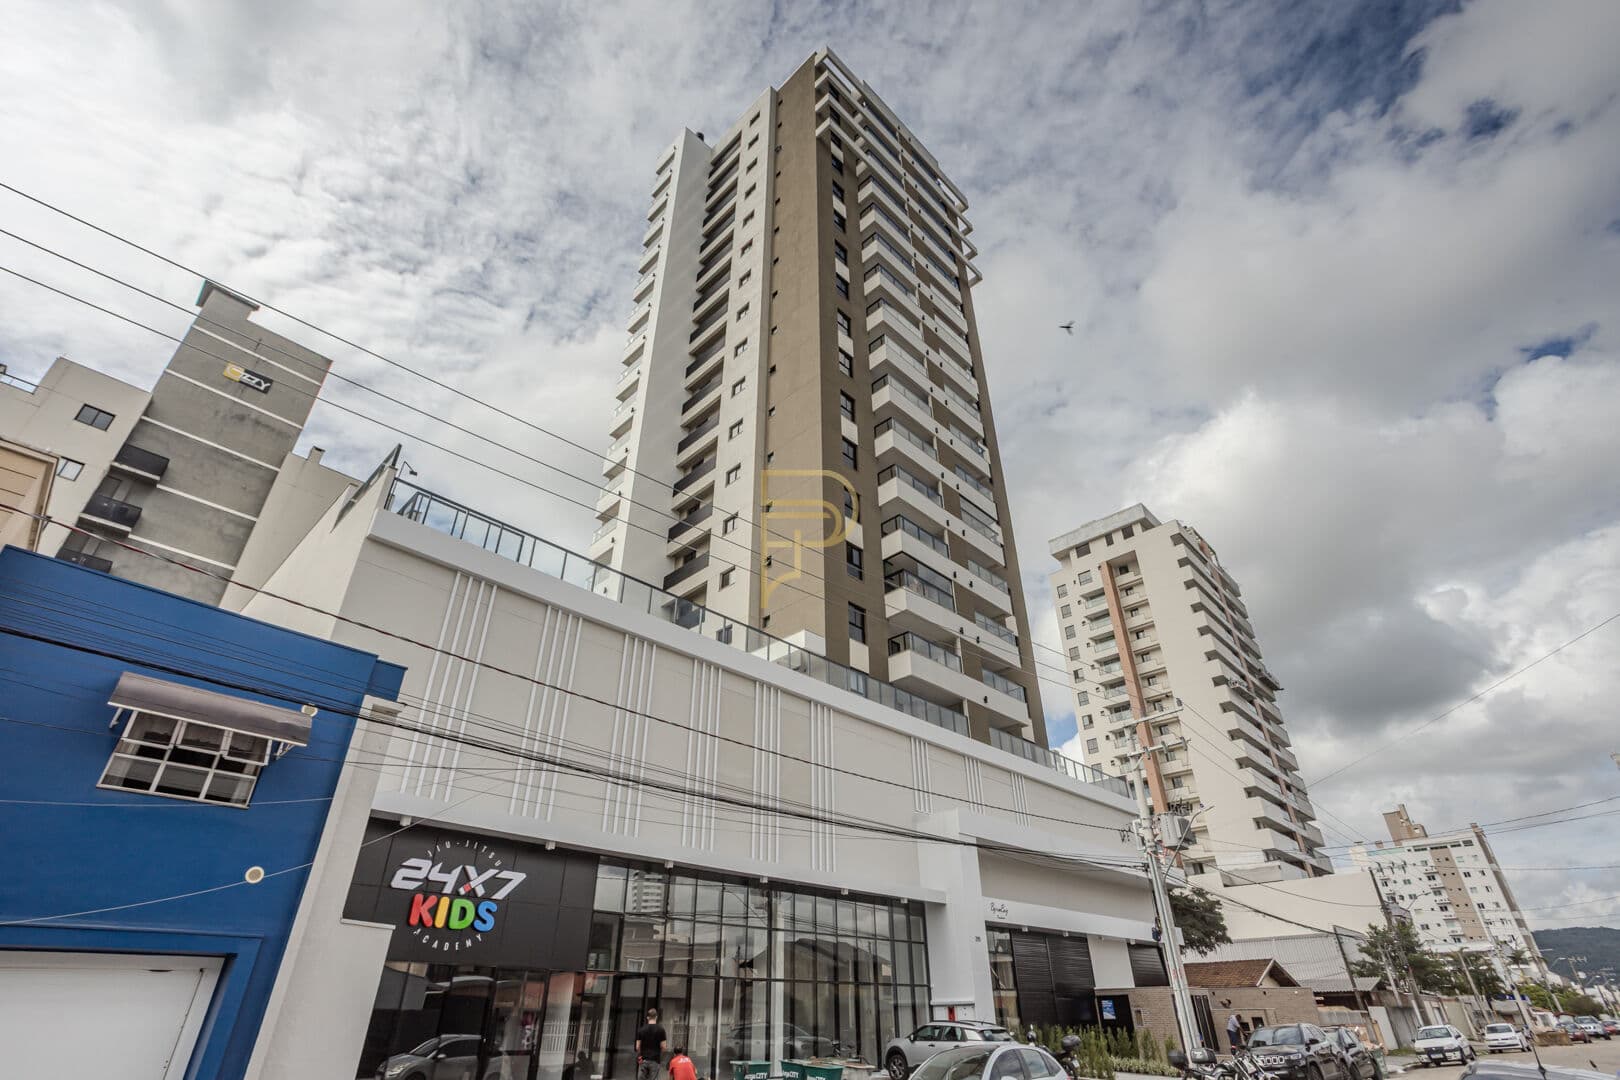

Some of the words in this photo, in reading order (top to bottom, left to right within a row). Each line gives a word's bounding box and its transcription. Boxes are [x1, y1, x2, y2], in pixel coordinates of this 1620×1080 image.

[427, 840, 502, 867] JIU-JITSU
[390, 858, 527, 900] 24X7
[408, 893, 498, 932] KIDS
[413, 928, 482, 951] ACADEMY
